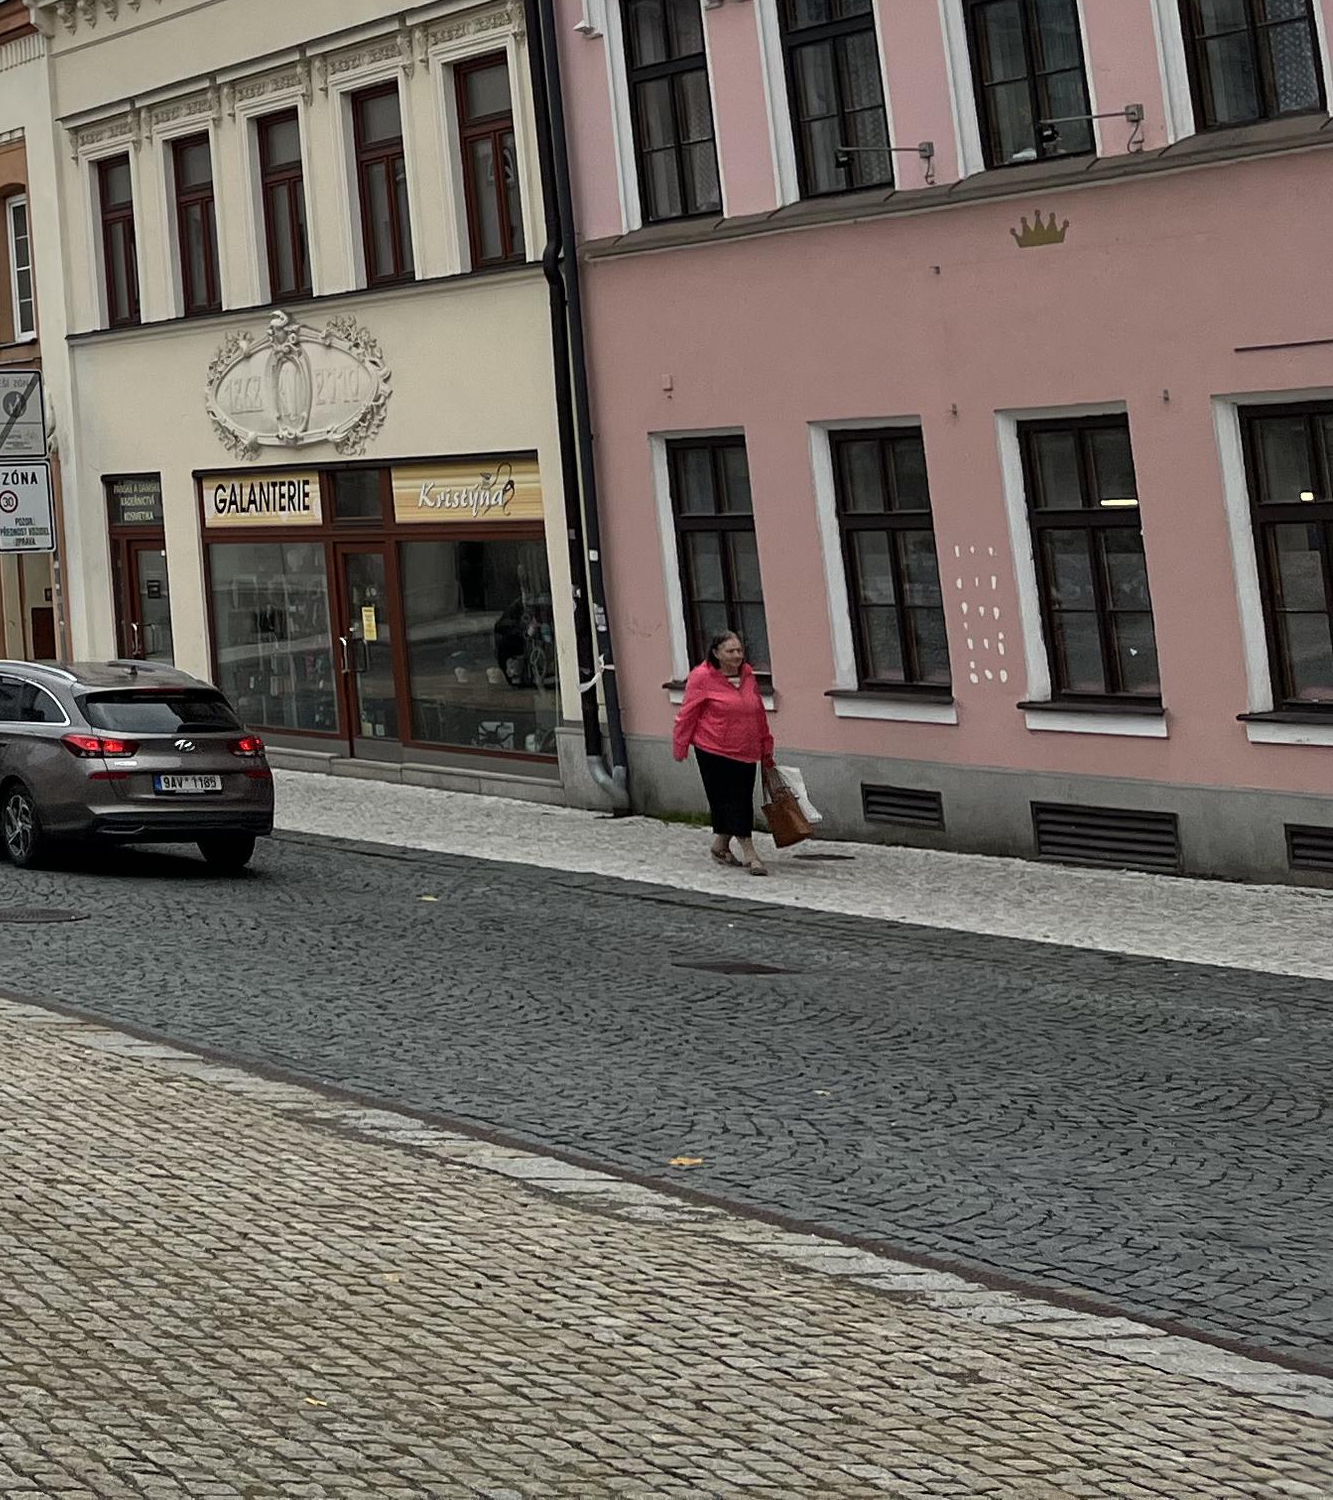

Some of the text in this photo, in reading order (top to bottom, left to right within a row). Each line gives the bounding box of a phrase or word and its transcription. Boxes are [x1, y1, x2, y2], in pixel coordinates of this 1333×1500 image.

[2, 470, 38, 485] ZÓNA
[3, 497, 14, 507] 30
[214, 480, 310, 514] GALANTERIE
[418, 482, 504, 517] Kristýna
[163, 776, 183, 789] 9AV
